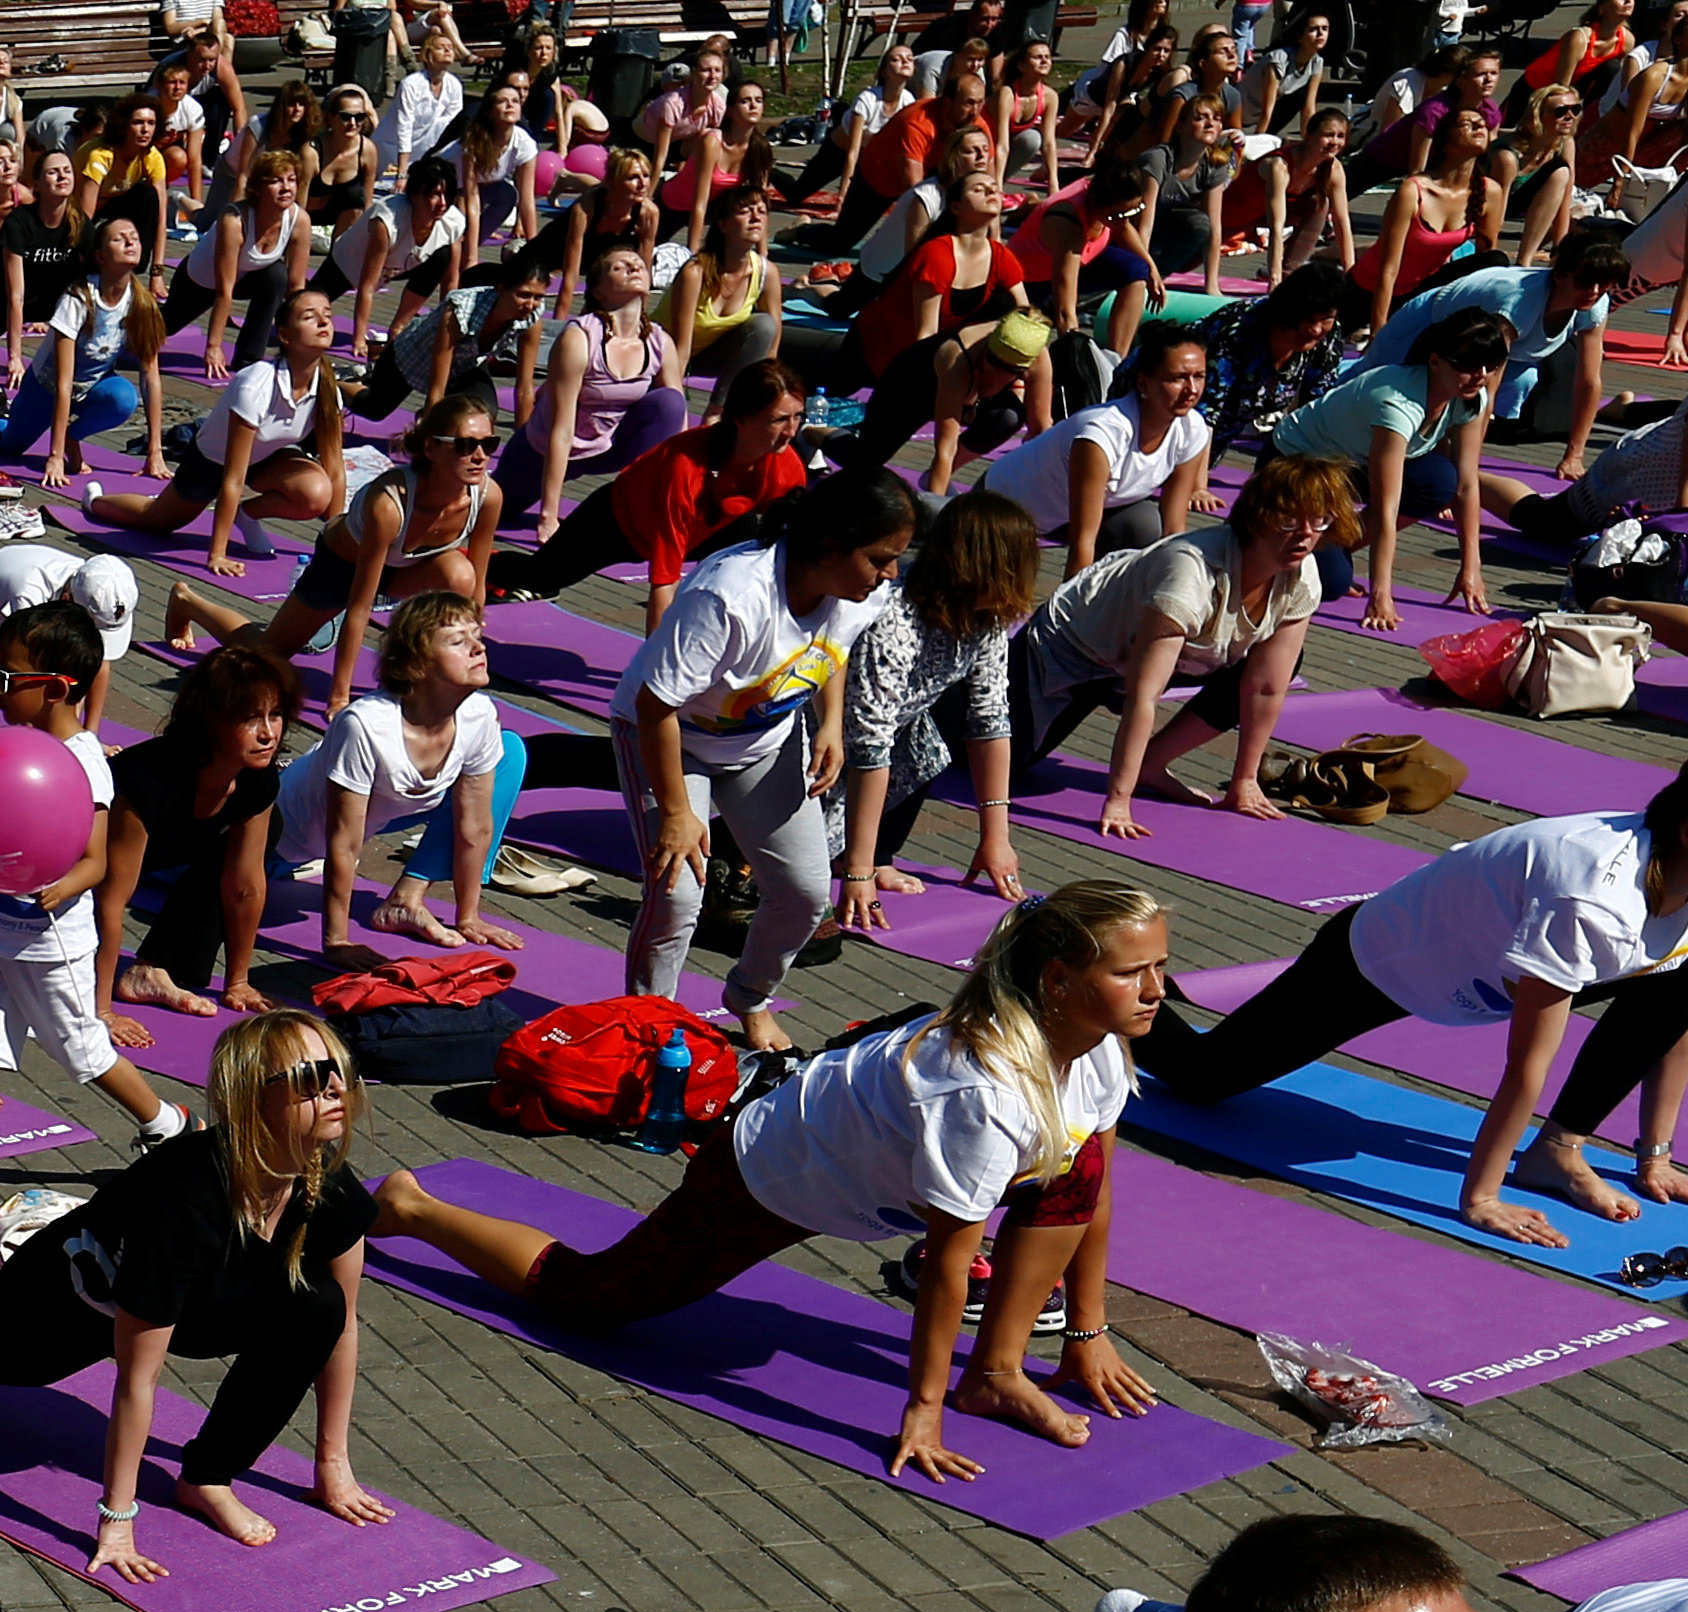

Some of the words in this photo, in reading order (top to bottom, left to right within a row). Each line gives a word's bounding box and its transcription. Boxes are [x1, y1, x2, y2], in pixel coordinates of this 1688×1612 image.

[1569, 1321, 1650, 1349] MARK
[1427, 1342, 1579, 1392] FORMELLE
[403, 1569, 501, 1598] MARK
